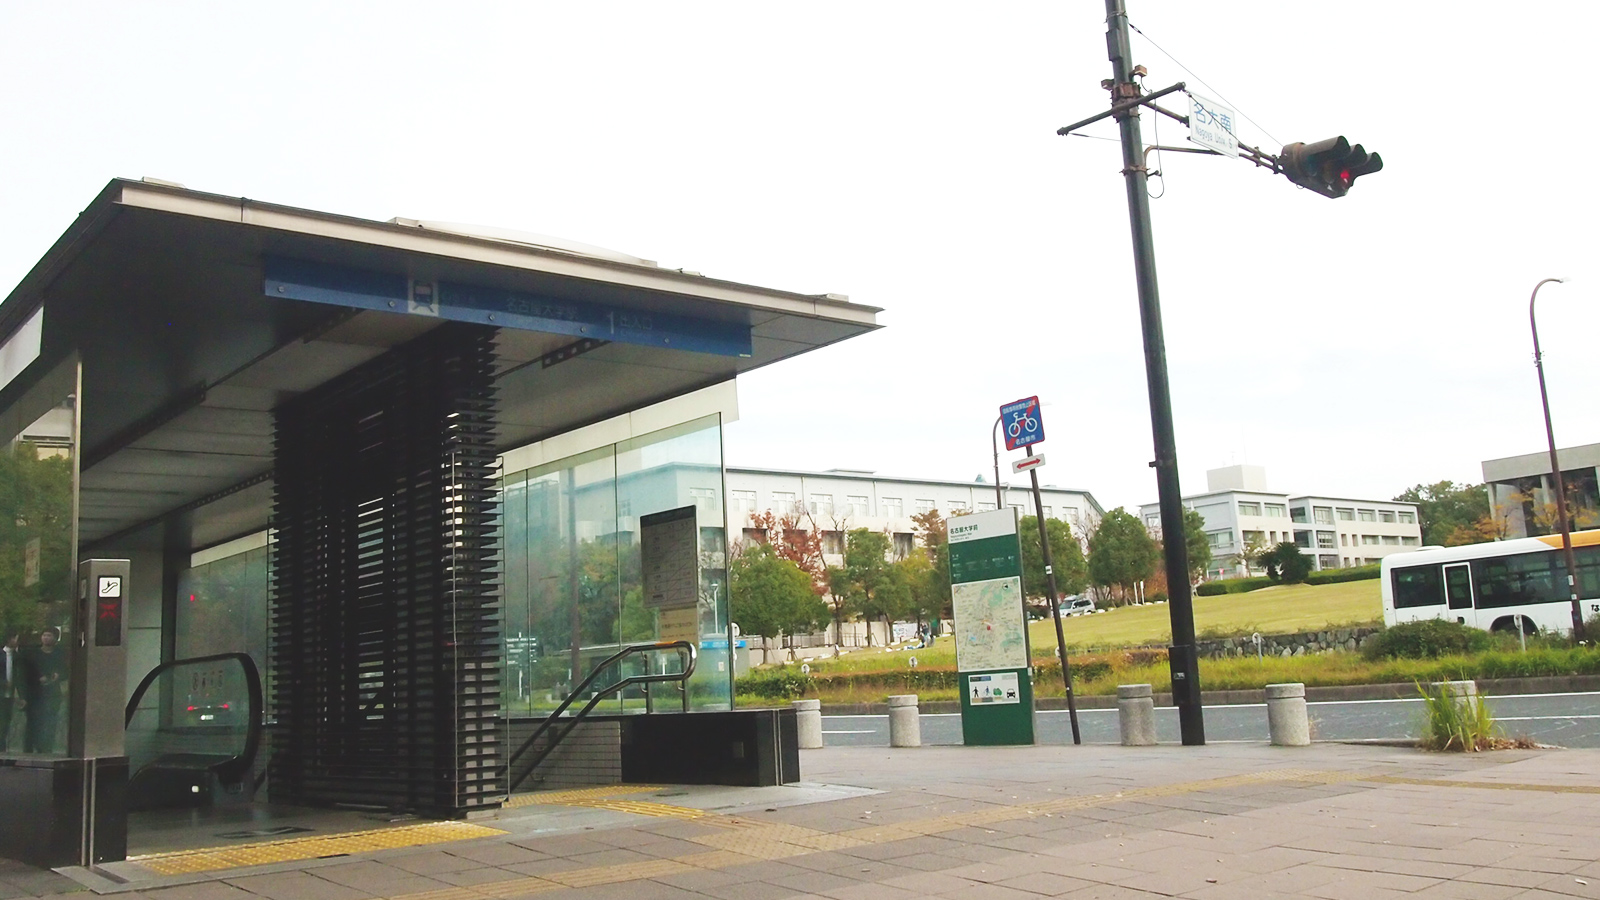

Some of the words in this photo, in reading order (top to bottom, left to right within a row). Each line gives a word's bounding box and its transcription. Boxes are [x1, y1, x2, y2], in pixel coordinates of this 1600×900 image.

[1194, 103, 1231, 133] 名大南
[1195, 125, 1212, 141] Nagoya
[606, 311, 615, 335] 1
[620, 315, 653, 331] 出入口
[1016, 435, 1036, 445] 名古屋市
